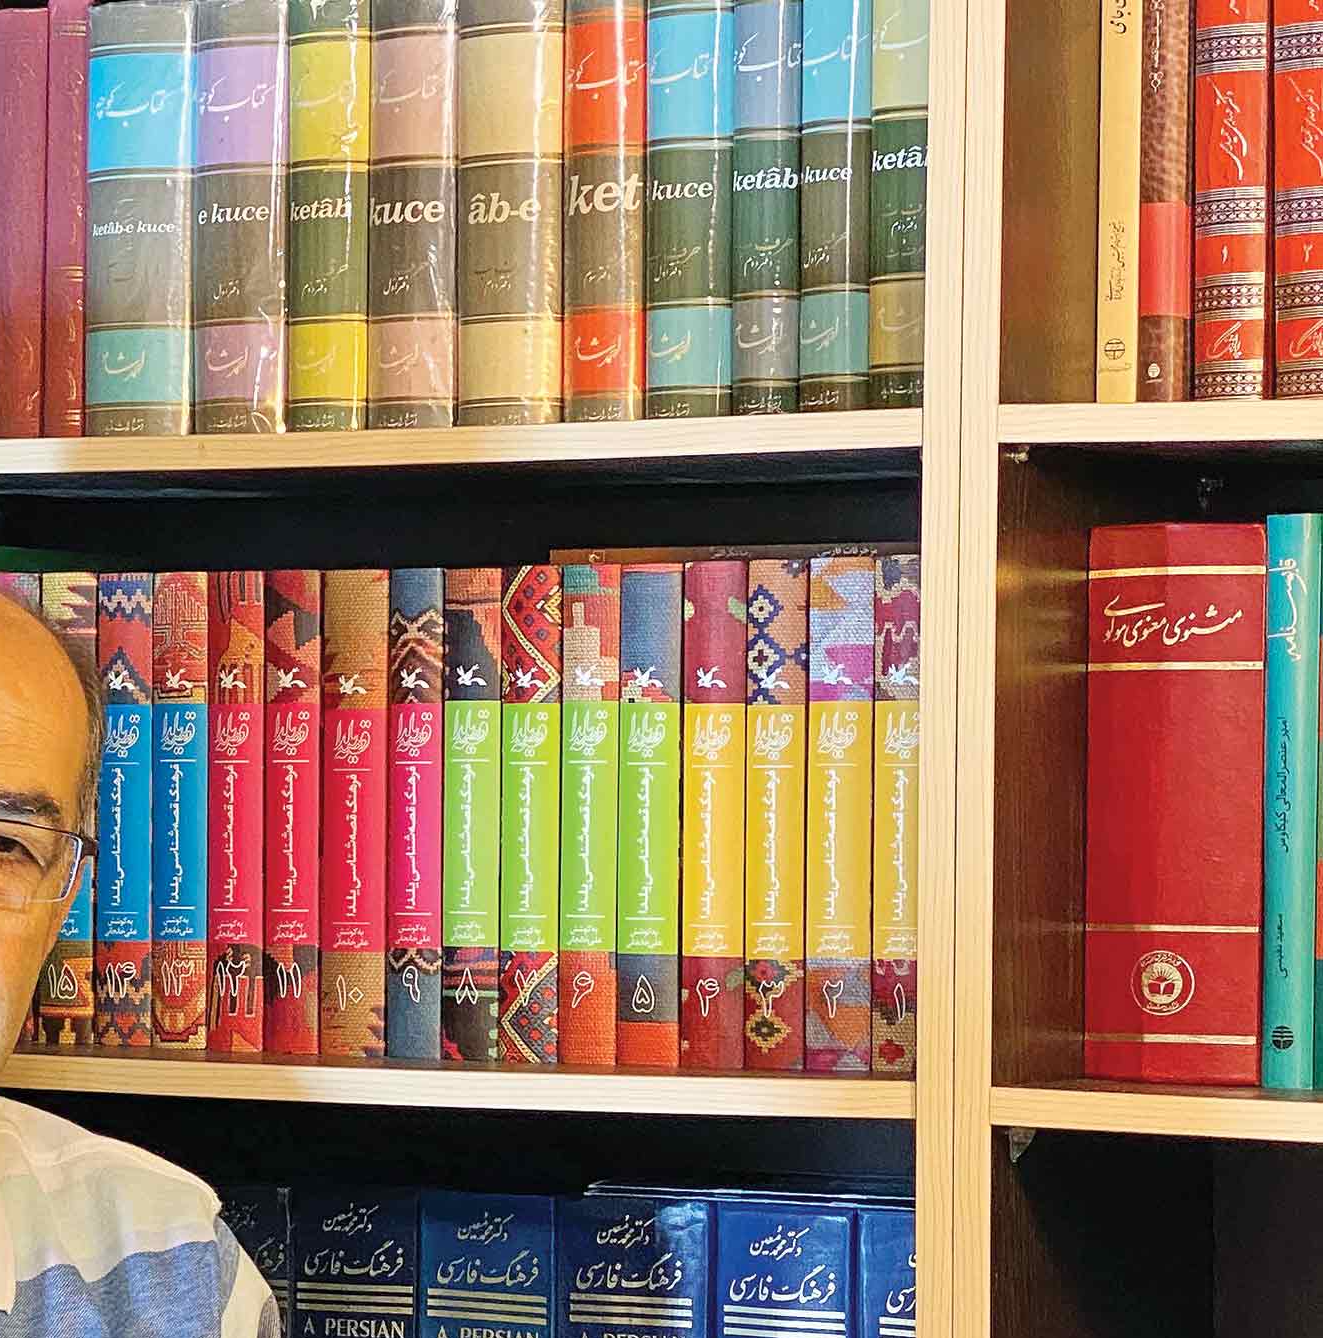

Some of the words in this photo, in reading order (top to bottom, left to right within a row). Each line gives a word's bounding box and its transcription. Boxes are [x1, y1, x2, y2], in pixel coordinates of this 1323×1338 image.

[651, 180, 714, 201] kuce
[733, 166, 799, 192] ketâb
[804, 165, 853, 184] kuce
[211, 203, 270, 224] kuce
[290, 194, 353, 223] ketâb
[370, 196, 445, 228] kuce
[467, 191, 542, 225] âb-e
[568, 173, 644, 217] ket
[137, 220, 175, 233] kuce
[1103, 593, 1166, 642] مولوی
[1122, 616, 1166, 647] معنوی
[1163, 603, 1243, 646] مثنوی
[1275, 717, 1289, 741] امیر
[168, 763, 184, 802] فرهنگ
[281, 764, 298, 804] فرهنگ
[346, 773, 361, 814] فرهنگ
[404, 765, 420, 806] فرهنگ
[1275, 810, 1290, 853] کیکاوس
[168, 874, 181, 904] یلدا
[282, 879, 296, 906] یلدا
[346, 888, 360, 917] یلدا
[405, 880, 420, 909] یلدا
[48, 962, 78, 999] ۱۵
[107, 960, 136, 999] ۱۴
[162, 958, 195, 996] ۱۳
[216, 958, 246, 998] ۱۲
[277, 962, 302, 998] ۱۱
[336, 974, 365, 1010] ۱۰
[402, 965, 420, 1003] ۹
[454, 967, 478, 1005] ۸
[514, 968, 538, 1007] ۷
[572, 970, 595, 1008] ۶
[631, 974, 655, 1013] ۵
[696, 979, 720, 1018] ۴
[758, 979, 785, 1018] ۳
[822, 979, 843, 1018] ۲
[894, 982, 905, 1021] ۱
[304, 1249, 345, 1276] فارسی
[343, 1240, 404, 1278] فرهنگ
[436, 1256, 480, 1285] فارسی
[479, 1250, 540, 1288] فرهنگ
[576, 1261, 621, 1291] فارسی
[620, 1252, 683, 1292] فرهنگ
[729, 1274, 773, 1302] فارسی
[771, 1264, 837, 1305] فرهنگ
[303, 1316, 315, 1335] A
